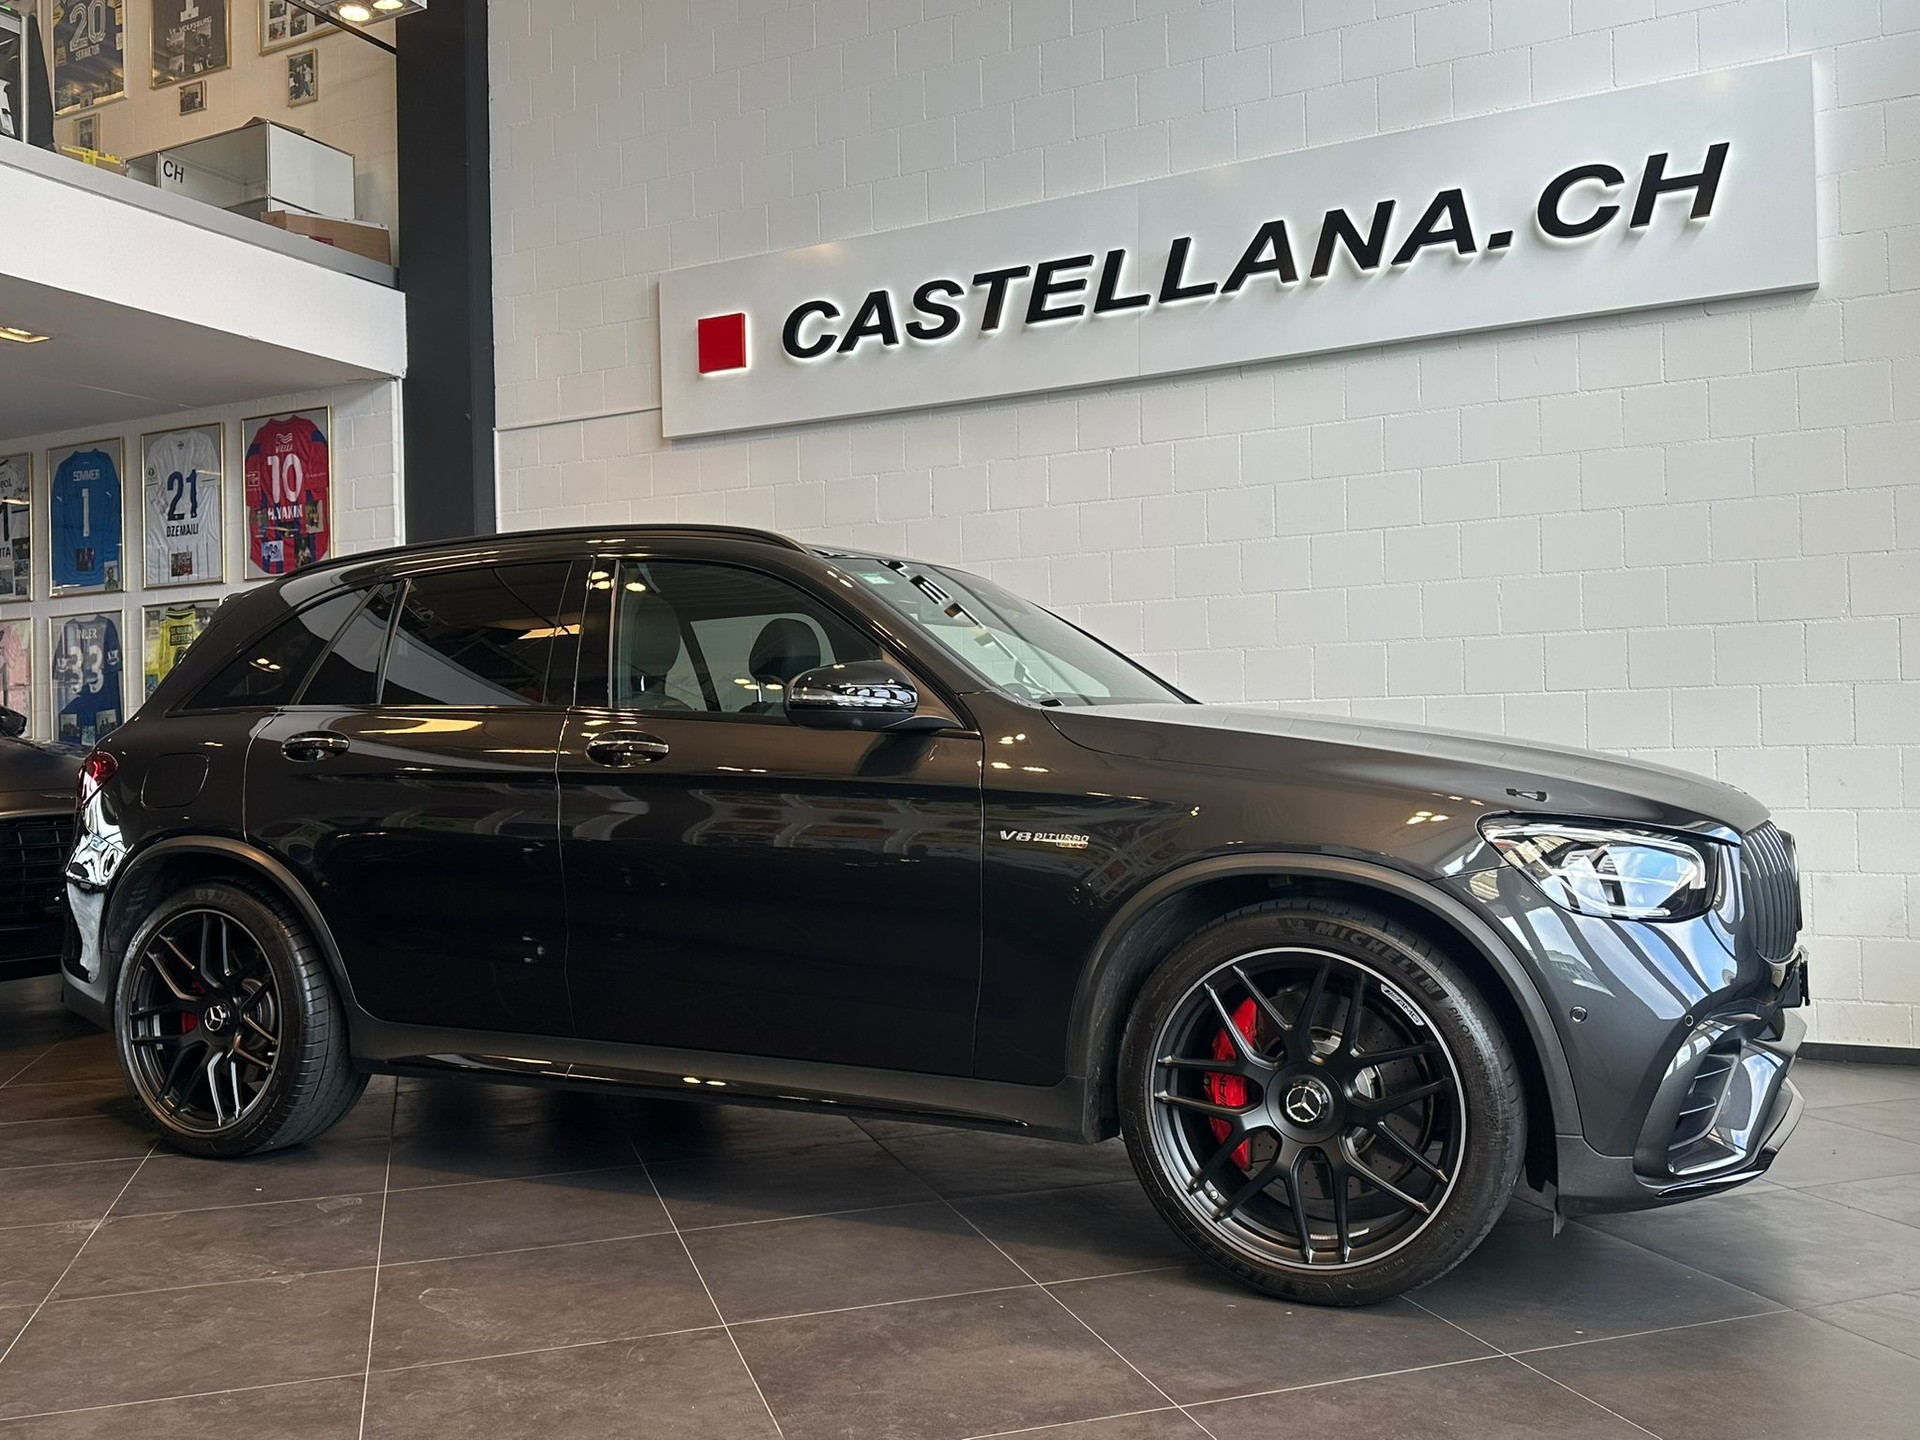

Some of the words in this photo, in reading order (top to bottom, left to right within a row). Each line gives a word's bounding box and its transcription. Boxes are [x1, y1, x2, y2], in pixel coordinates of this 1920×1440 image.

[69, 0, 106, 53] 20
[163, 160, 184, 183] CH
[781, 141, 1729, 360] CASTELLANA.CH
[73, 469, 100, 481] SOMMER
[167, 469, 198, 521] 21
[267, 453, 303, 504] 10
[81, 488, 90, 537] 1
[166, 523, 199, 537] DZEMAILI
[267, 504, 304, 520] H.YAKIN
[70, 645, 104, 694] 33
[1000, 830, 1032, 842] V8
[1033, 832, 1090, 845] BITURBO
[1315, 922, 1442, 996] MICHELIN
